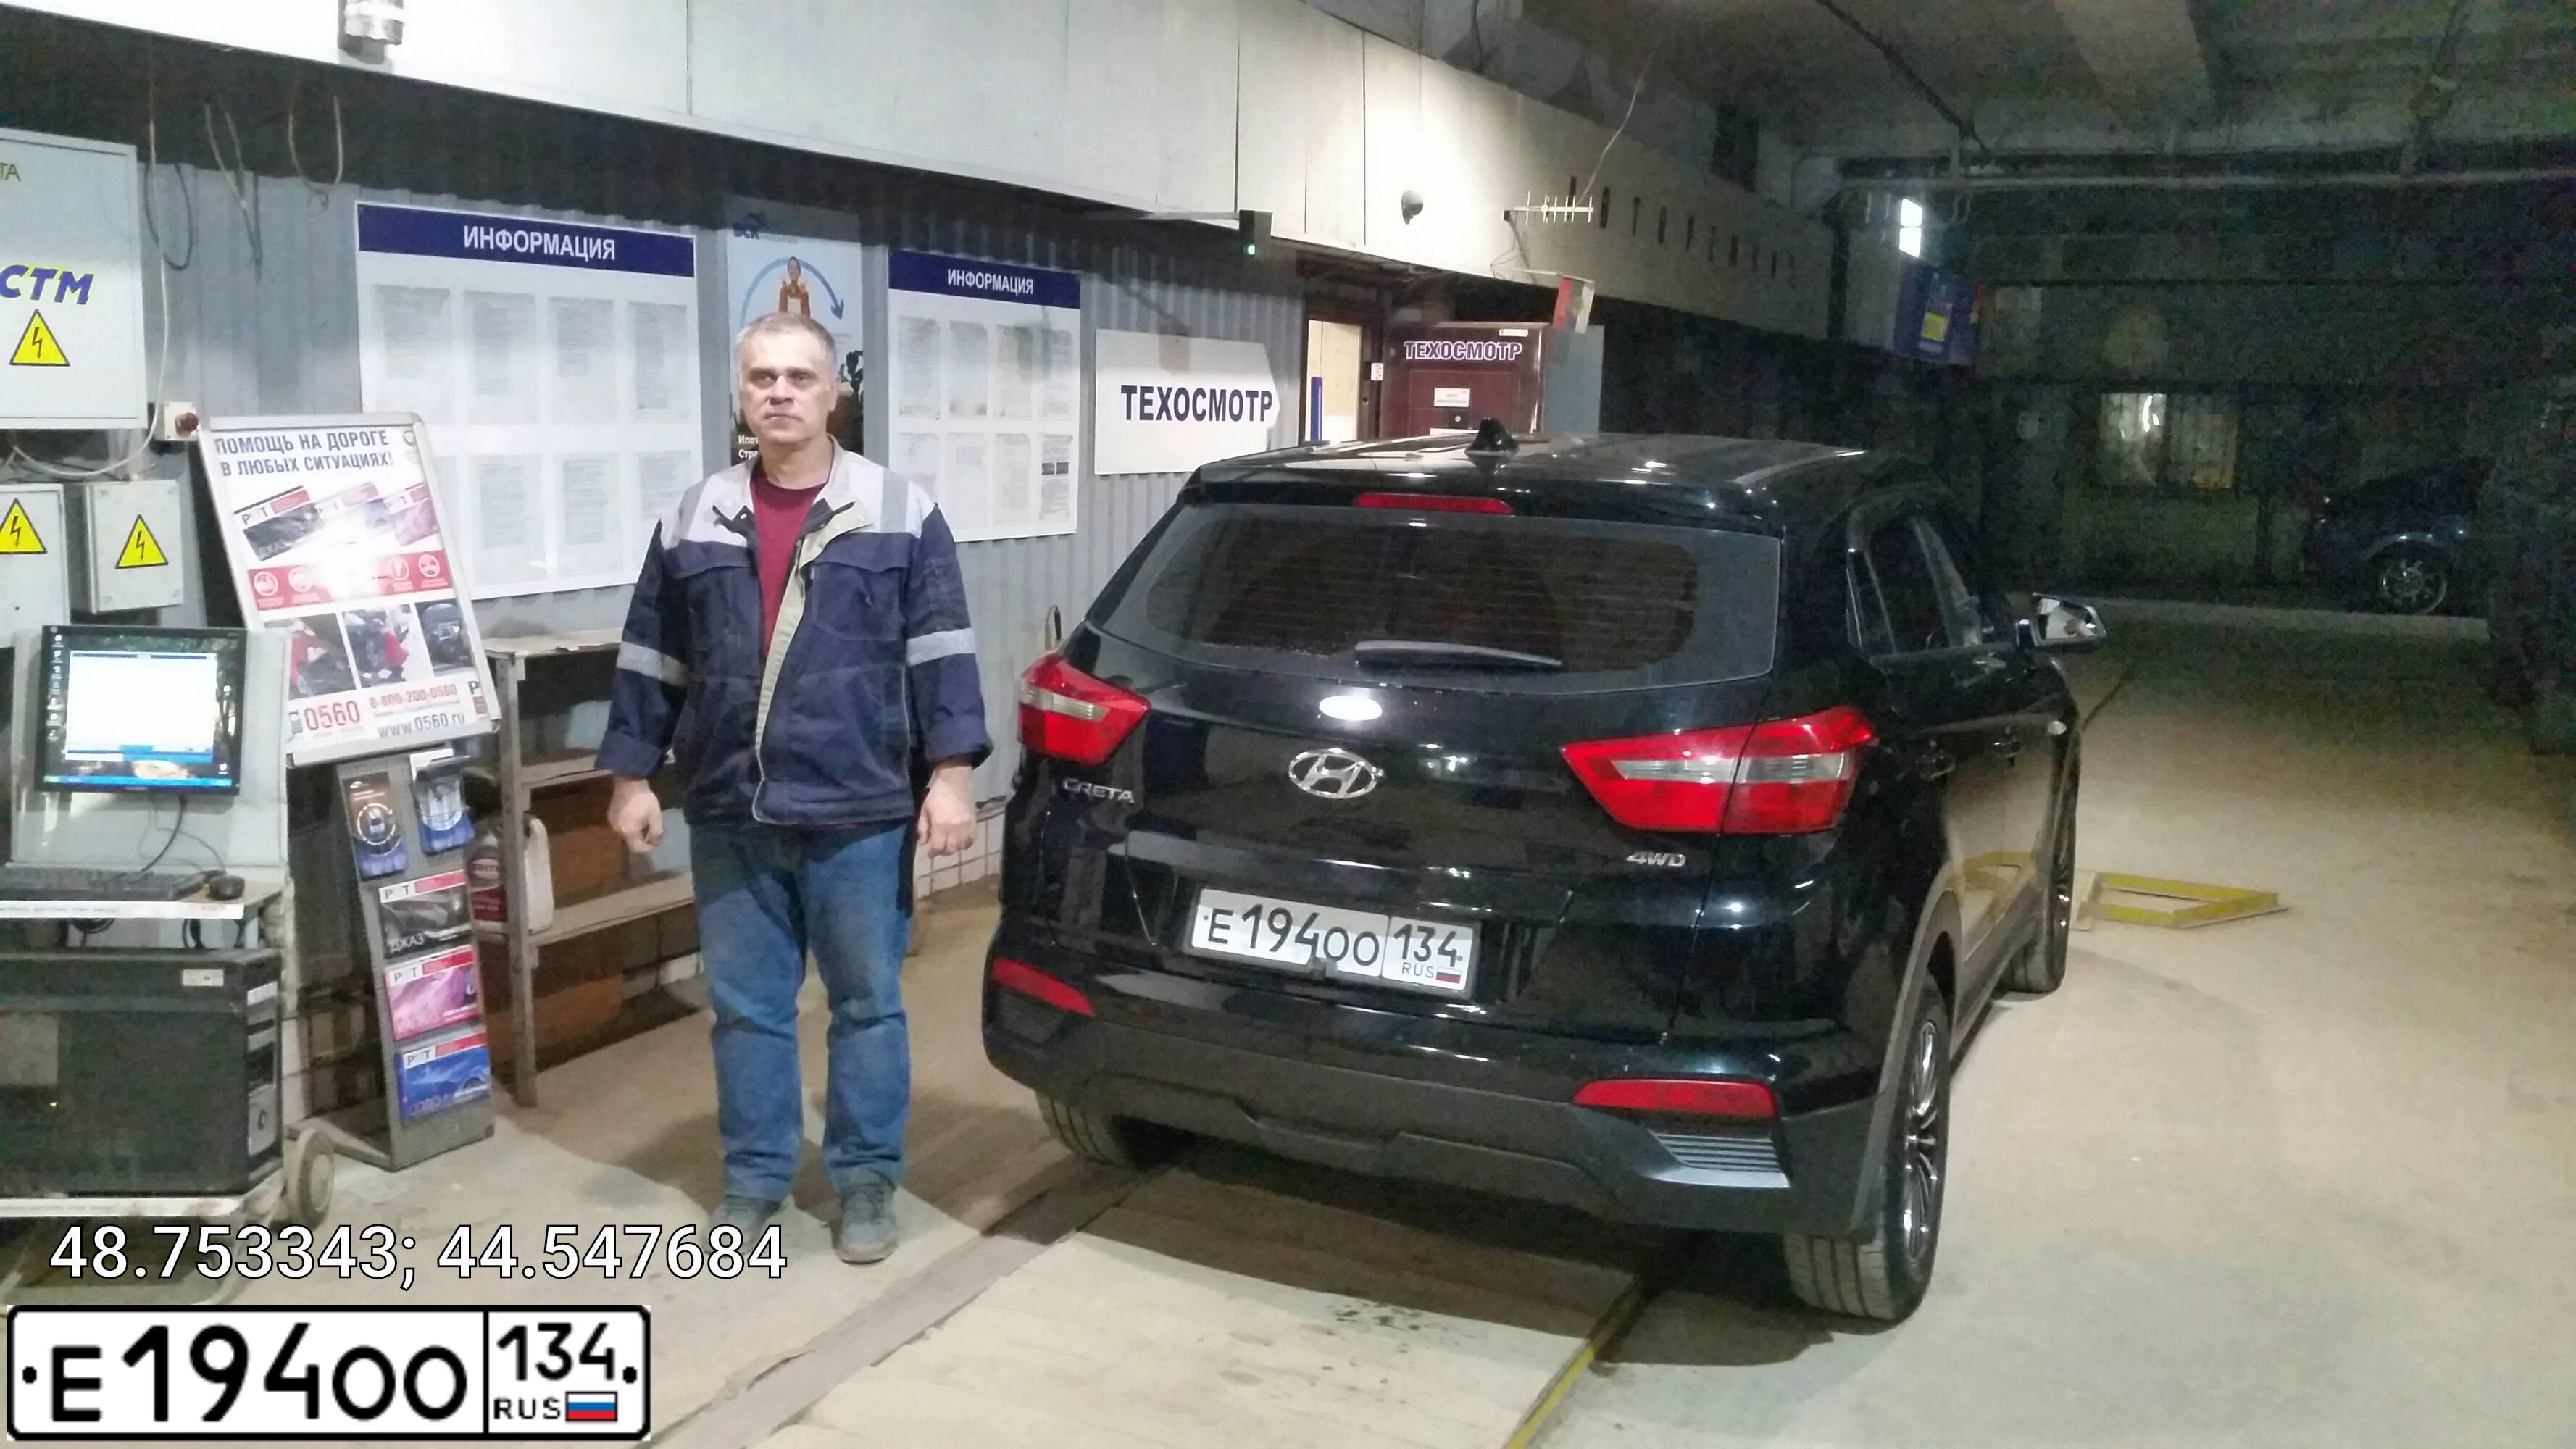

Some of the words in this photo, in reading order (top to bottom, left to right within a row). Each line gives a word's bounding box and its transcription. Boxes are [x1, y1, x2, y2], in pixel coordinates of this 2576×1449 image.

[464, 225, 615, 262] ИНФОРМАЦИЯ
[0, 264, 94, 305] СТМ
[947, 268, 1034, 294] ИНФОРМАЦИЯ
[1404, 341, 1522, 361] ТЕХОСМОТР
[1120, 384, 1273, 422] ТЕХОСМОТР
[214, 435, 294, 454] ПОМОЩЬ
[299, 434, 322, 450] НА
[326, 430, 389, 451] ДОРОГЕ
[220, 461, 232, 476] В
[237, 457, 299, 476] ЛЮБЫХ
[304, 452, 394, 472] СИТУАЦИЯХ!
[370, 684, 457, 709] 8-800-200-0560
[304, 700, 361, 732] 0560
[1062, 778, 1135, 803] CRETA
[1626, 851, 1686, 867] 4WD
[1393, 924, 1459, 967] 134
[1402, 962, 1434, 979] RUS
